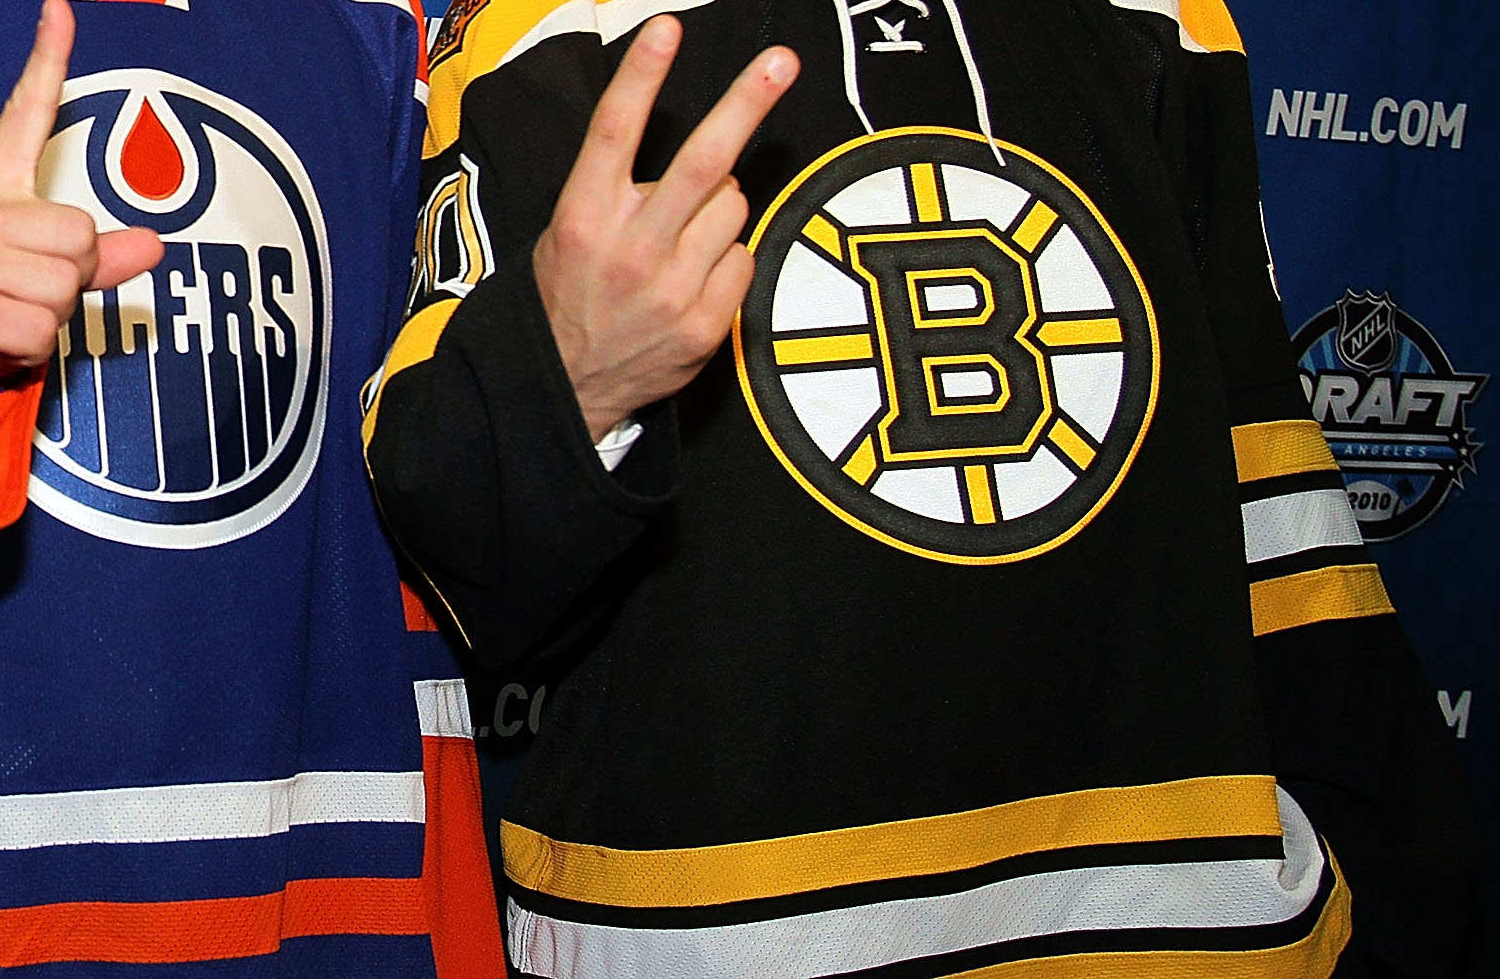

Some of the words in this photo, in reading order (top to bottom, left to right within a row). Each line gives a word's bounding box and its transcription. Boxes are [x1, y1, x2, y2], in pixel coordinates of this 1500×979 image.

[1266, 89, 1467, 149] NHL.COM
[847, 227, 1053, 462] B
[1351, 315, 1385, 354] NHL
[1344, 445, 1428, 458] ANGELES
[1349, 492, 1391, 510] 2010
